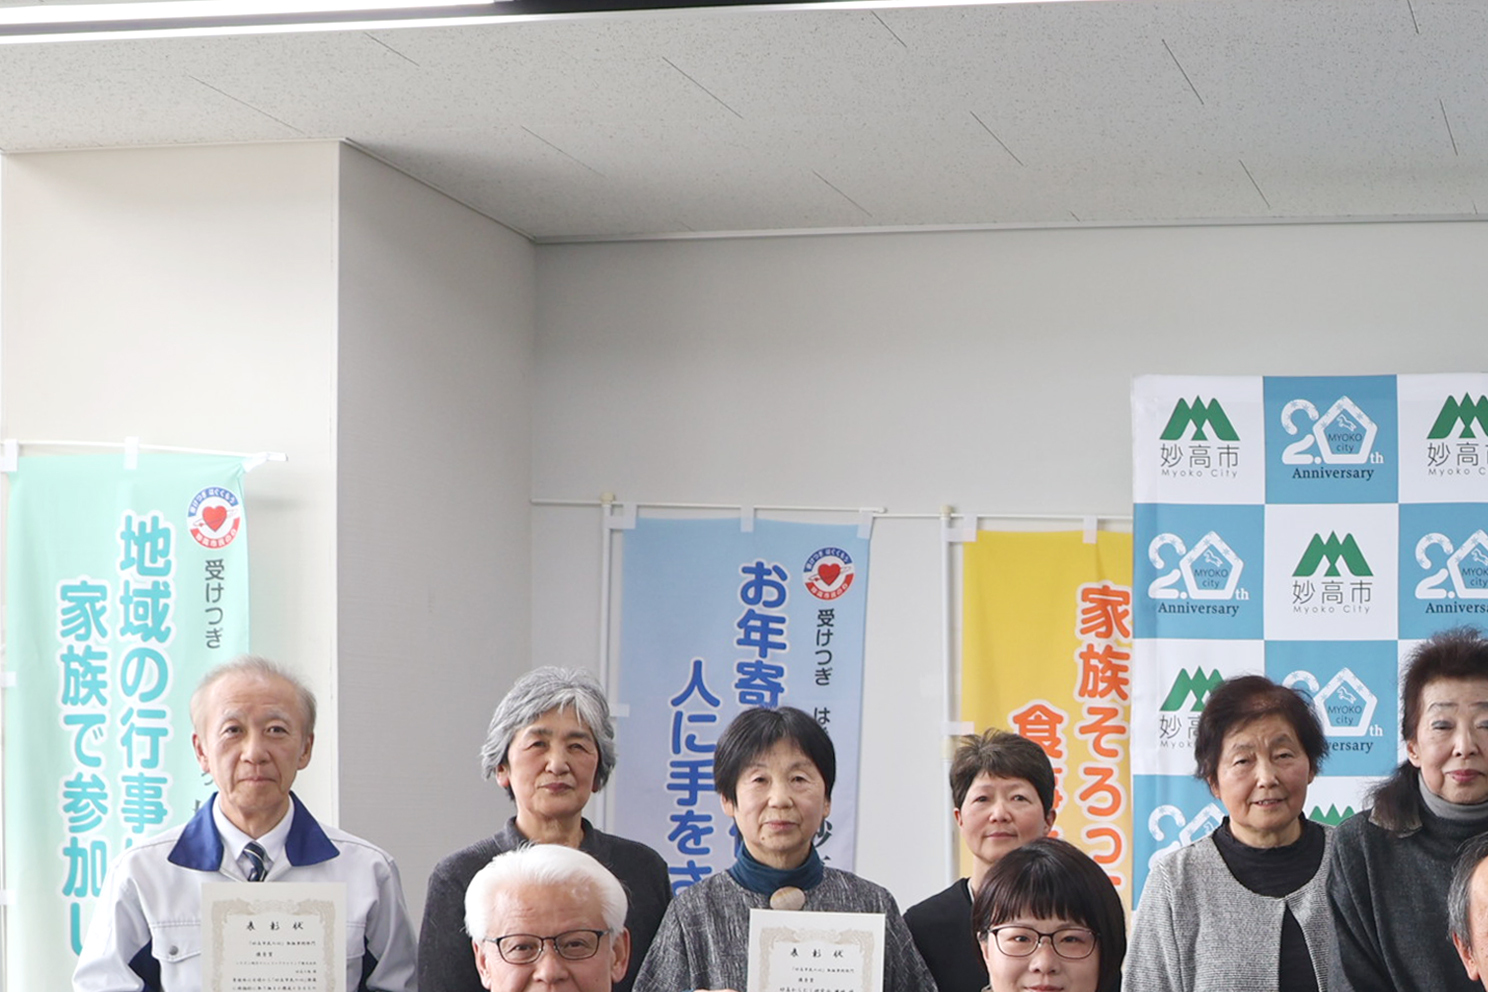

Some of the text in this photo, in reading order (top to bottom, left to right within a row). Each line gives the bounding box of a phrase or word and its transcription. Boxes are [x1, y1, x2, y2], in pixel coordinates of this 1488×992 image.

[1328, 433, 1362, 442] MYOKO
[1335, 443, 1354, 453] city
[1160, 443, 1240, 469] 妙高市
[1161, 468, 1238, 478] Myoko City
[1290, 466, 1374, 482] Anniversary
[1426, 467, 1470, 477] Myoko
[1195, 568, 1229, 577] MYOKO
[1202, 578, 1221, 588] city
[1469, 577, 1488, 587] city
[1291, 580, 1373, 605] 妙高市
[204, 558, 226, 649] 受けつぎ
[1157, 601, 1241, 617] Anniversary
[1291, 604, 1371, 615] Myoko City
[814, 608, 835, 686] 受けつぎ
[120, 515, 171, 849] 地域の行事
[1327, 705, 1362, 714] MYOKO
[1336, 717, 1354, 726] city
[1079, 585, 1131, 886] 家族そろっ
[1160, 741, 1194, 749] Myok
